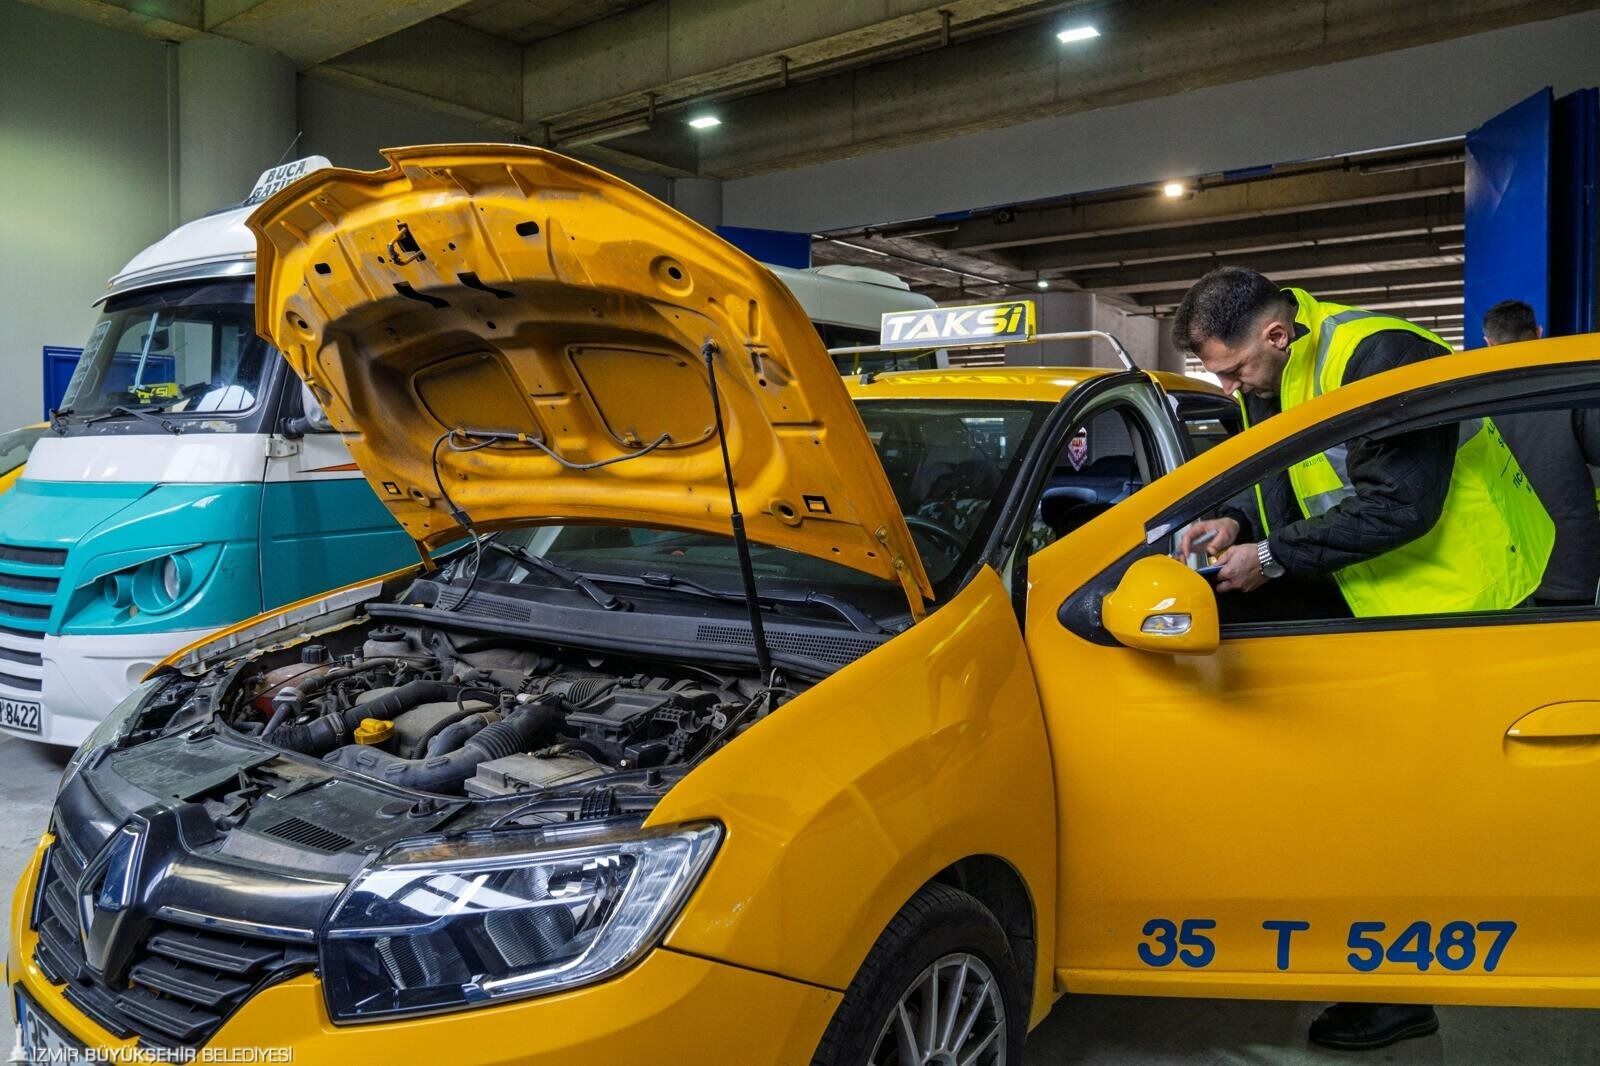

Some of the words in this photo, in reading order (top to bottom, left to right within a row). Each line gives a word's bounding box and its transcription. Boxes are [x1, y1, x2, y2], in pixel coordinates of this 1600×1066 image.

[6, 702, 38, 729] 8422
[1137, 918, 1217, 969] 35
[1262, 920, 1311, 971] T
[1346, 920, 1518, 973] 5487
